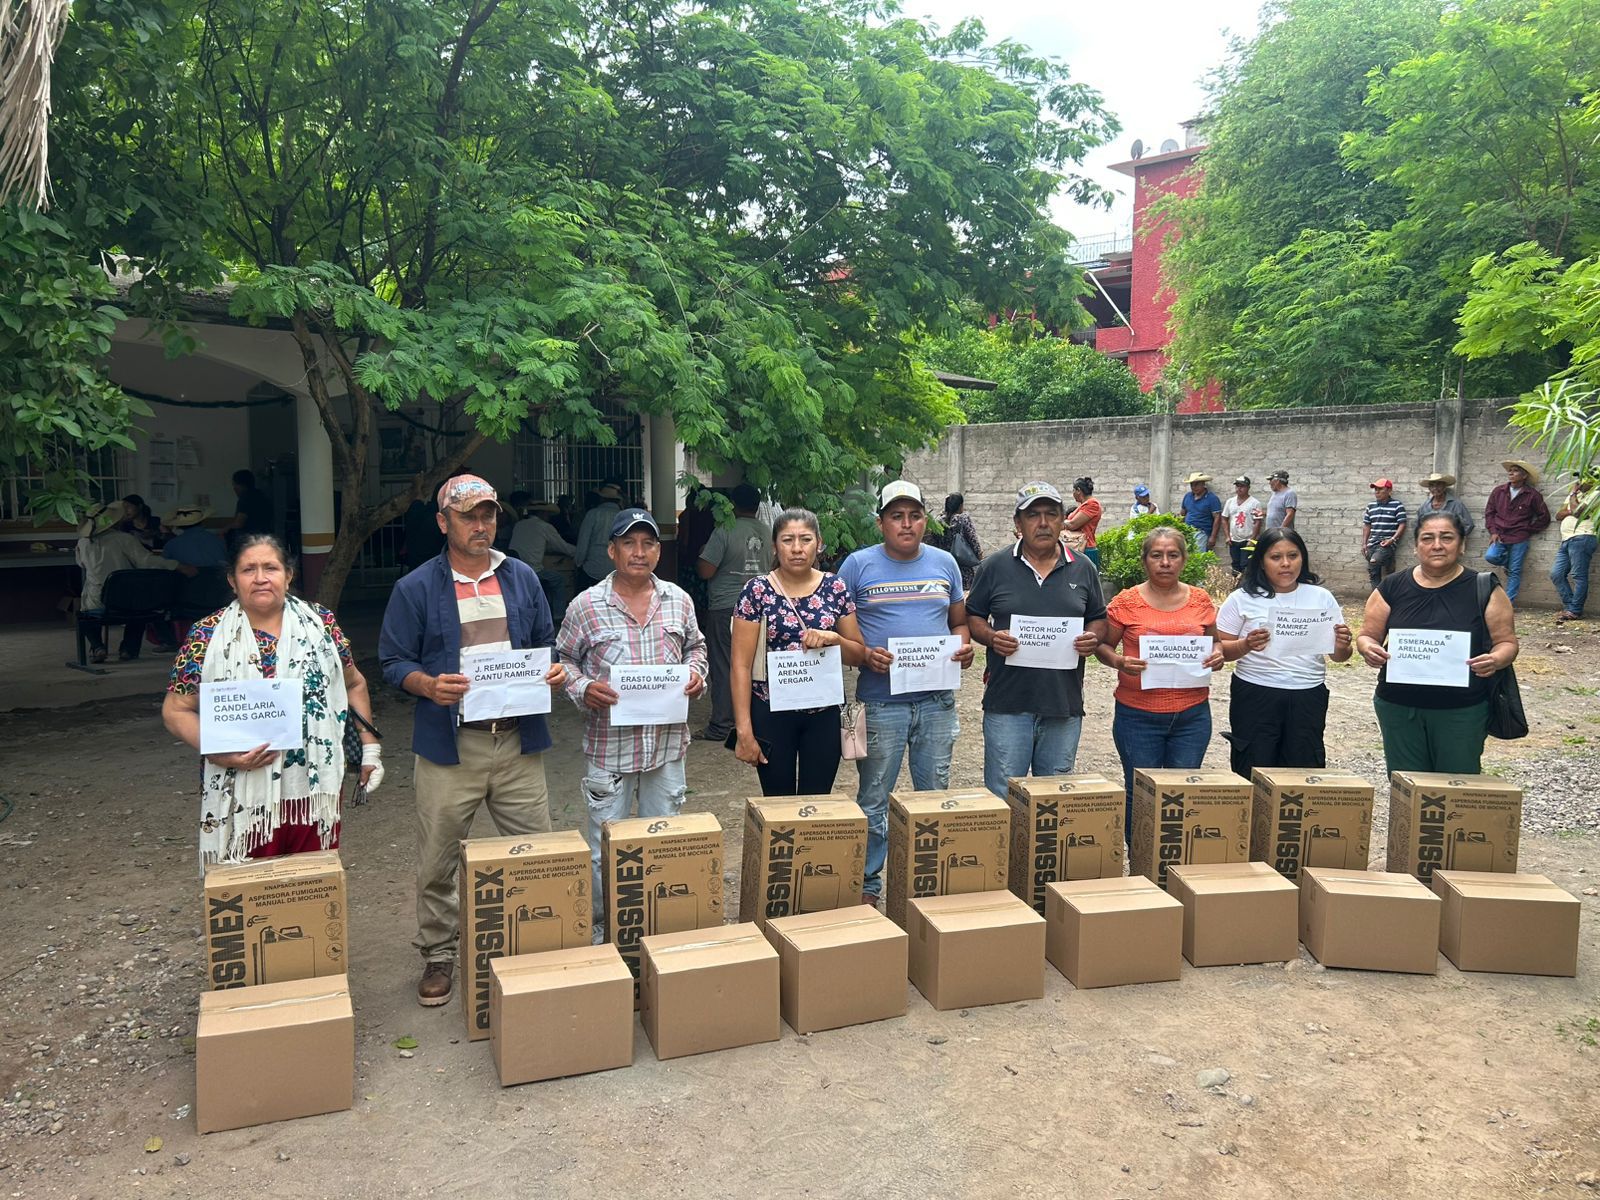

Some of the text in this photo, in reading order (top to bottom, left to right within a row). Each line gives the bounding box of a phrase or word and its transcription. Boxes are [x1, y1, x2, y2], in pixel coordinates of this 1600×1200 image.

[868, 585, 919, 595] YELLOWSTONE
[1398, 638, 1446, 646] ESMERALDA
[484, 661, 526, 672] REMEDIOS
[799, 659, 820, 667] DELIA
[474, 669, 542, 682] CANTU RAMIREZ
[778, 669, 808, 677] ARENAS
[620, 675, 652, 683] ERASTO
[778, 676, 814, 685] VERGARA
[213, 693, 246, 703] BELEN
[213, 701, 276, 712] CANDELARIA
[214, 710, 286, 722] ROSAS GARCIA
[1275, 792, 1304, 879] ISSMEX
[647, 843, 720, 854] ASPERSORA FUMIGADORA
[687, 849, 713, 857] MOCHILA
[914, 820, 939, 898] SMEX
[1033, 801, 1058, 917] ISSMEX
[508, 863, 587, 876] ASPERSORA FUMIGADORA
[552, 870, 580, 878] MOCHILA
[765, 828, 795, 918] SSMEX
[264, 882, 296, 891] KNAPSACK
[248, 885, 337, 902] ASPERSORA FUMIGADORA
[255, 899, 286, 908] MANUAL
[297, 892, 330, 902] MOCHILA
[209, 894, 246, 990] SMEX
